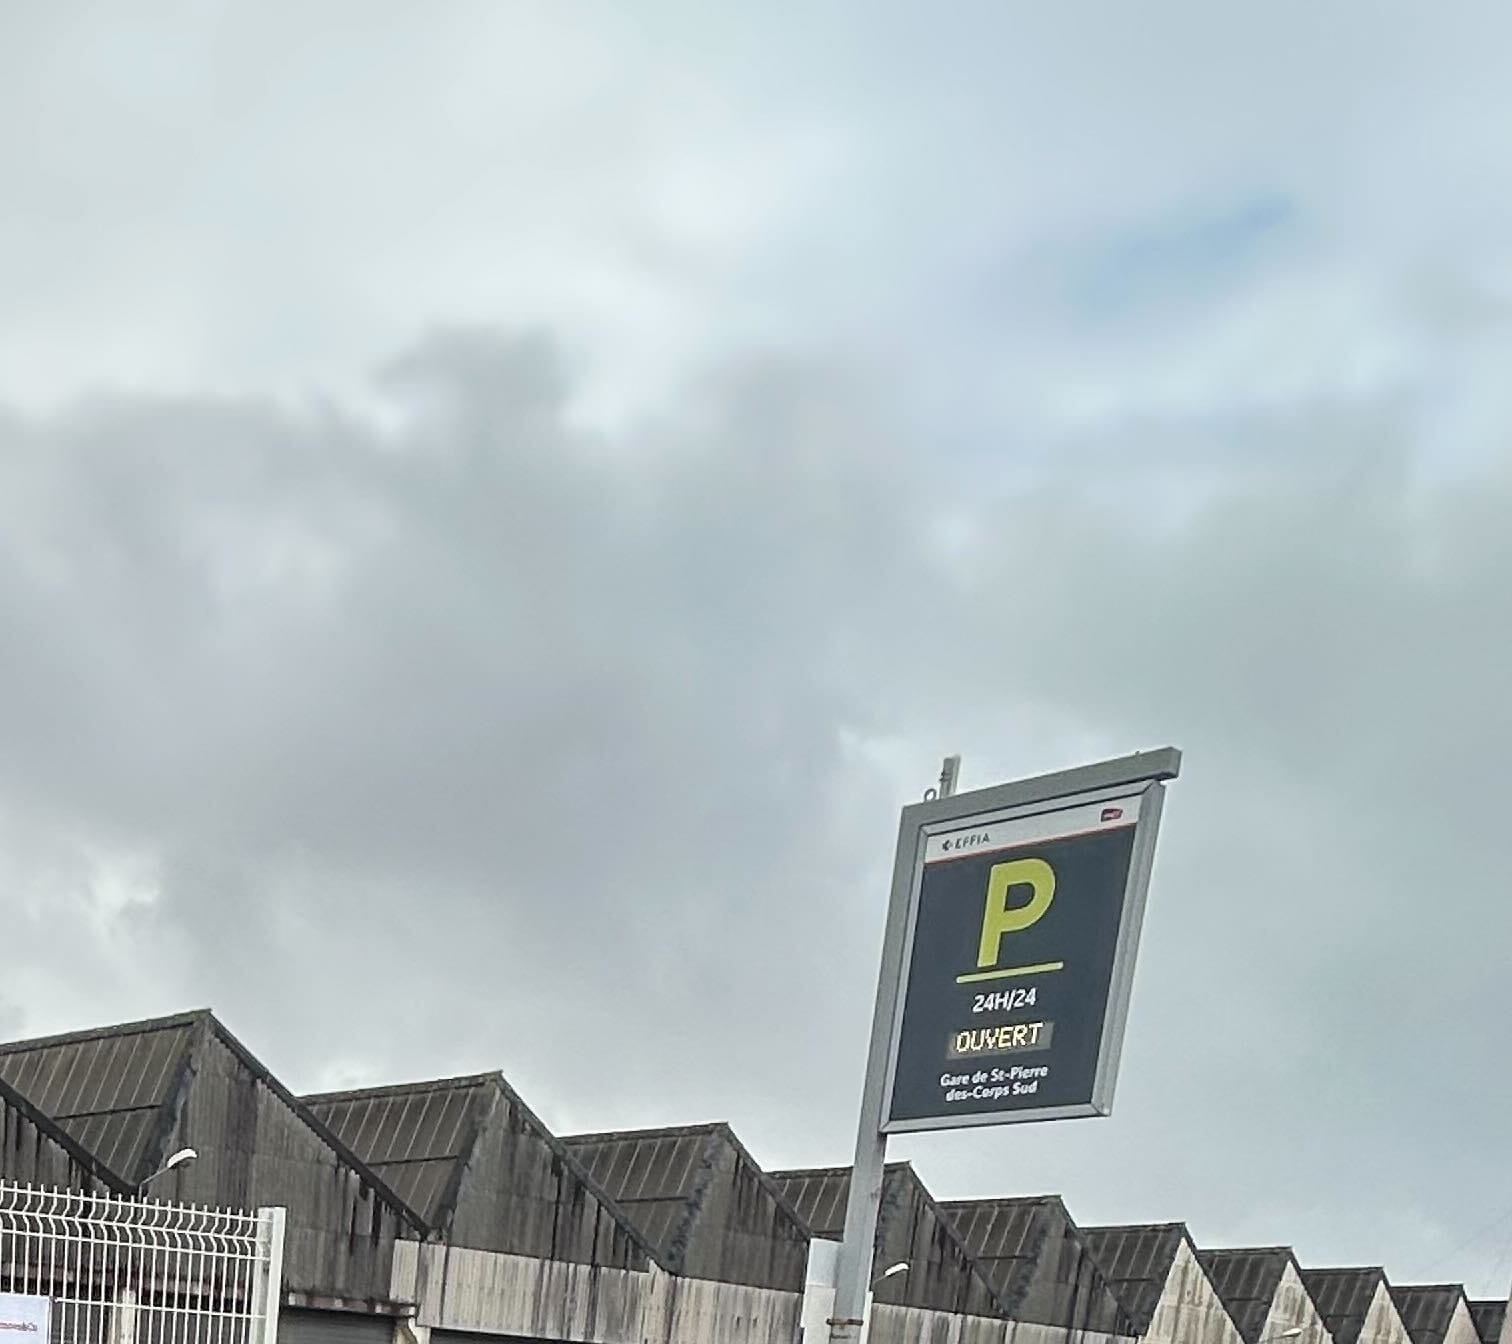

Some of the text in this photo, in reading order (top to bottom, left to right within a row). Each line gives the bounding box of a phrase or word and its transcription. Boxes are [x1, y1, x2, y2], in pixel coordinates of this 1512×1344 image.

[954, 832, 990, 850] EFFIA
[977, 857, 1056, 968] P
[972, 987, 1037, 1014] 24H/24
[955, 1022, 1044, 1053] OUVERT
[940, 1065, 1049, 1087] Gare de St-Pierre
[1012, 1080, 1039, 1095] Sud
